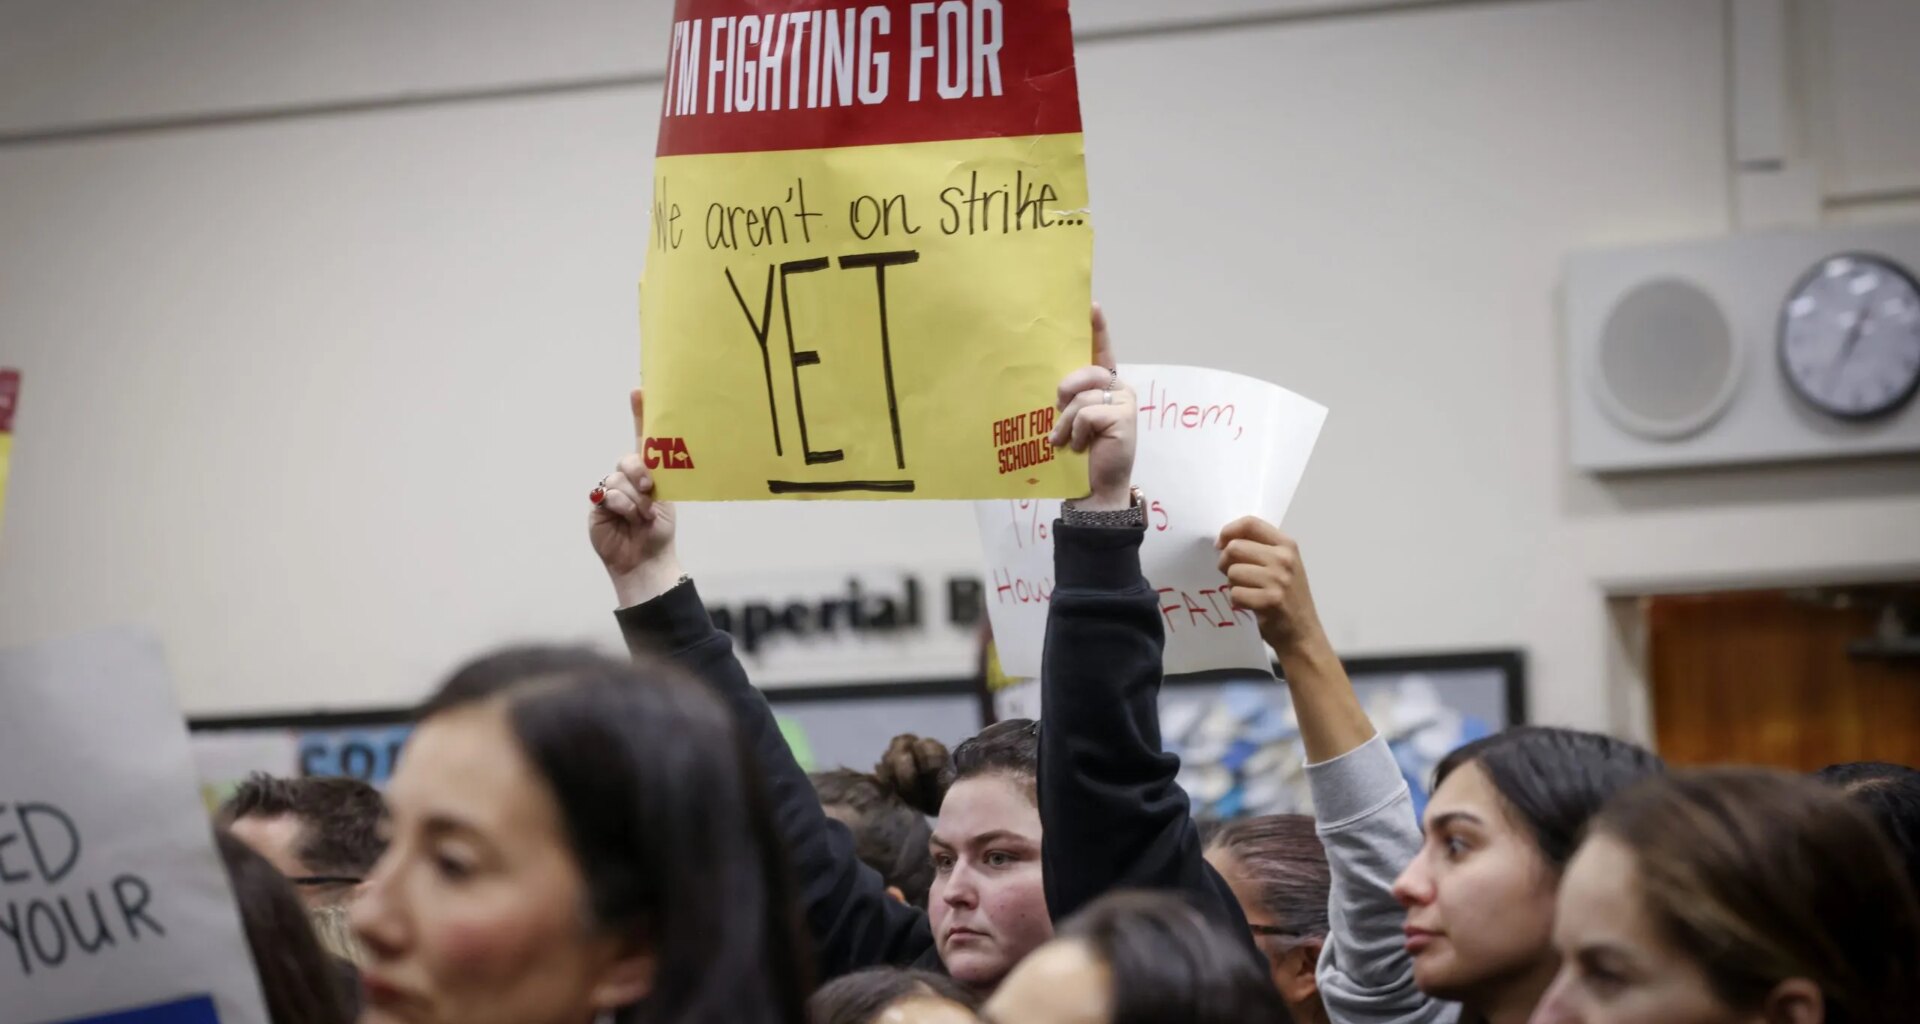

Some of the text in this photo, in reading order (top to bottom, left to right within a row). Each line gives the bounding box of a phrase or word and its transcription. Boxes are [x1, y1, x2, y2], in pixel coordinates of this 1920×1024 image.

[665, 0, 1004, 117] I'M FIGHTING FOR
[705, 177, 823, 250] aren't
[850, 194, 921, 240] on
[940, 170, 1084, 236] strike...
[725, 249, 920, 469] YET
[993, 406, 1054, 448] FIGHT FOR
[1139, 379, 1243, 441] them,
[643, 436, 695, 470] CTA
[998, 436, 1054, 474] SCHOOLS!
[993, 567, 1052, 604] How
[0, 873, 166, 977] YOUR
